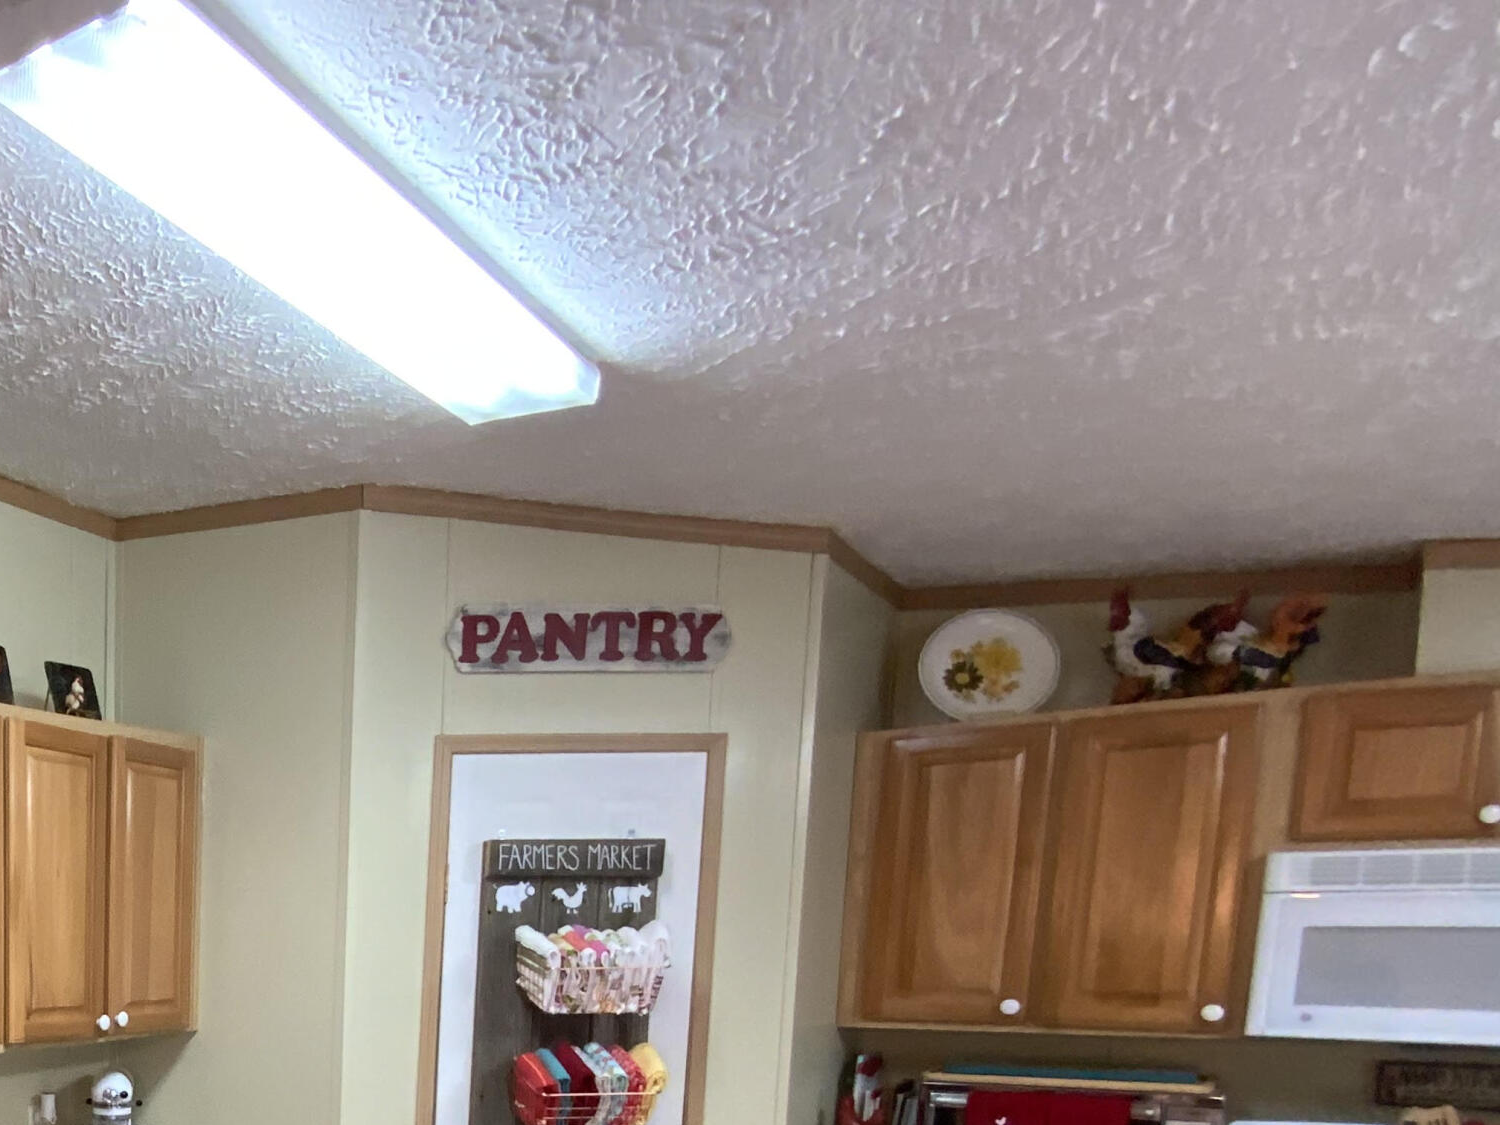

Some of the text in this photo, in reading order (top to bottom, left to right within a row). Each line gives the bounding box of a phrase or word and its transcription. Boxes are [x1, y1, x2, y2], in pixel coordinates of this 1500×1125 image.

[458, 611, 723, 663] PANTRY
[498, 843, 657, 872] FARMERS MARKET
